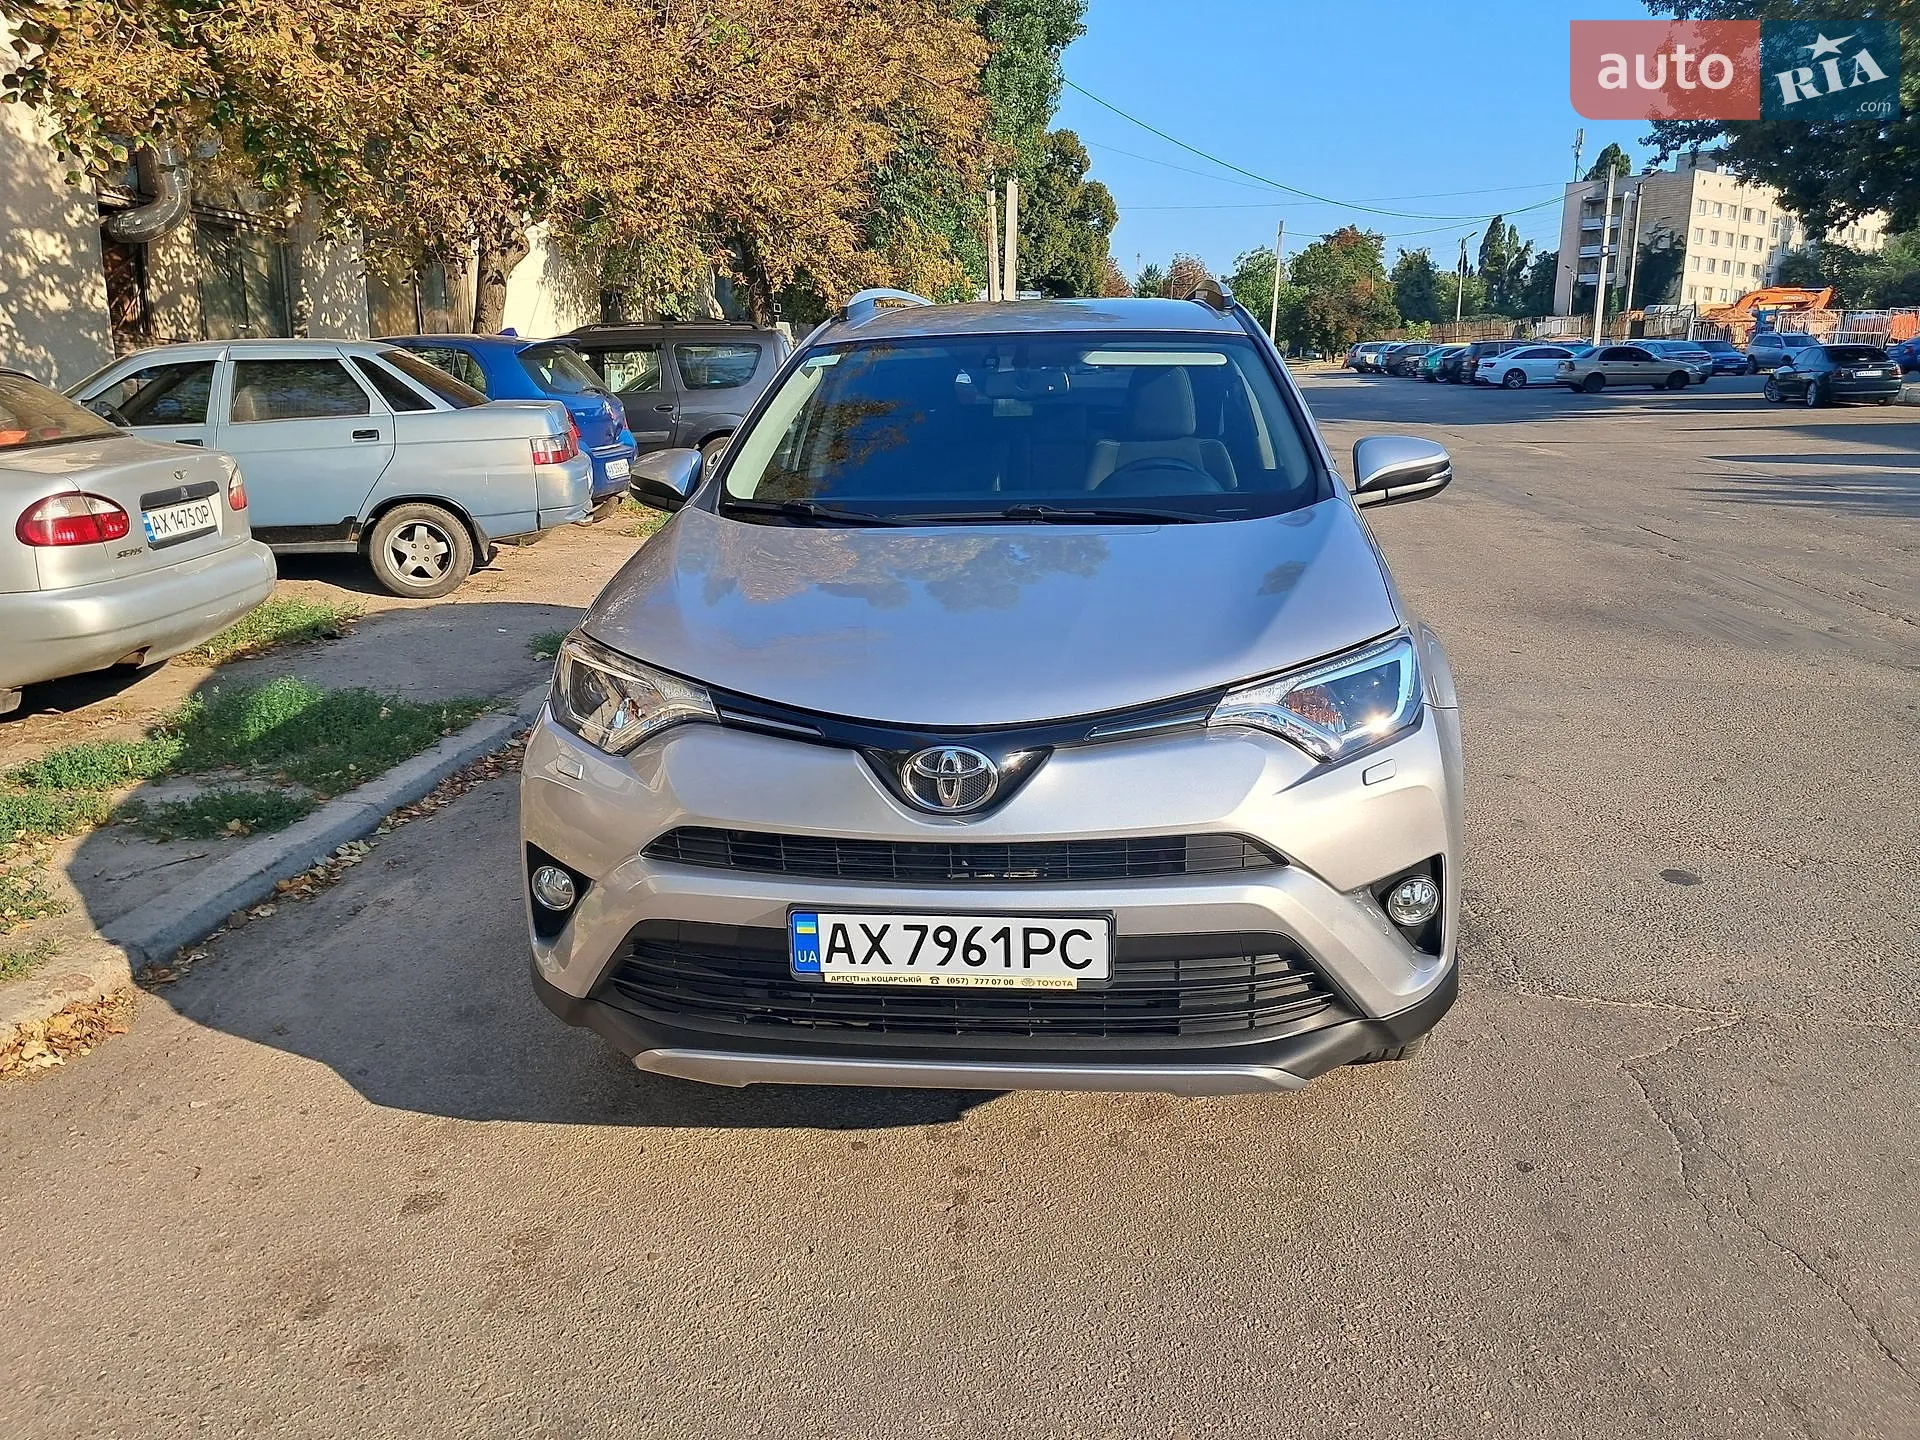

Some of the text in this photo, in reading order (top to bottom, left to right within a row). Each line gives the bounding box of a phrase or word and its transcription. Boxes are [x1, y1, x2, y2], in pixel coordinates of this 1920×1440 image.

[152, 513, 172, 535] AX
[170, 509, 195, 530] 1475
[825, 922, 893, 965] AX
[903, 924, 1012, 968] 7961
[798, 951, 818, 964] UA
[871, 976, 922, 984] КОЦАРСЬКІЙ
[946, 977, 969, 985] (057)
[1036, 979, 1073, 987] TOYOTA
